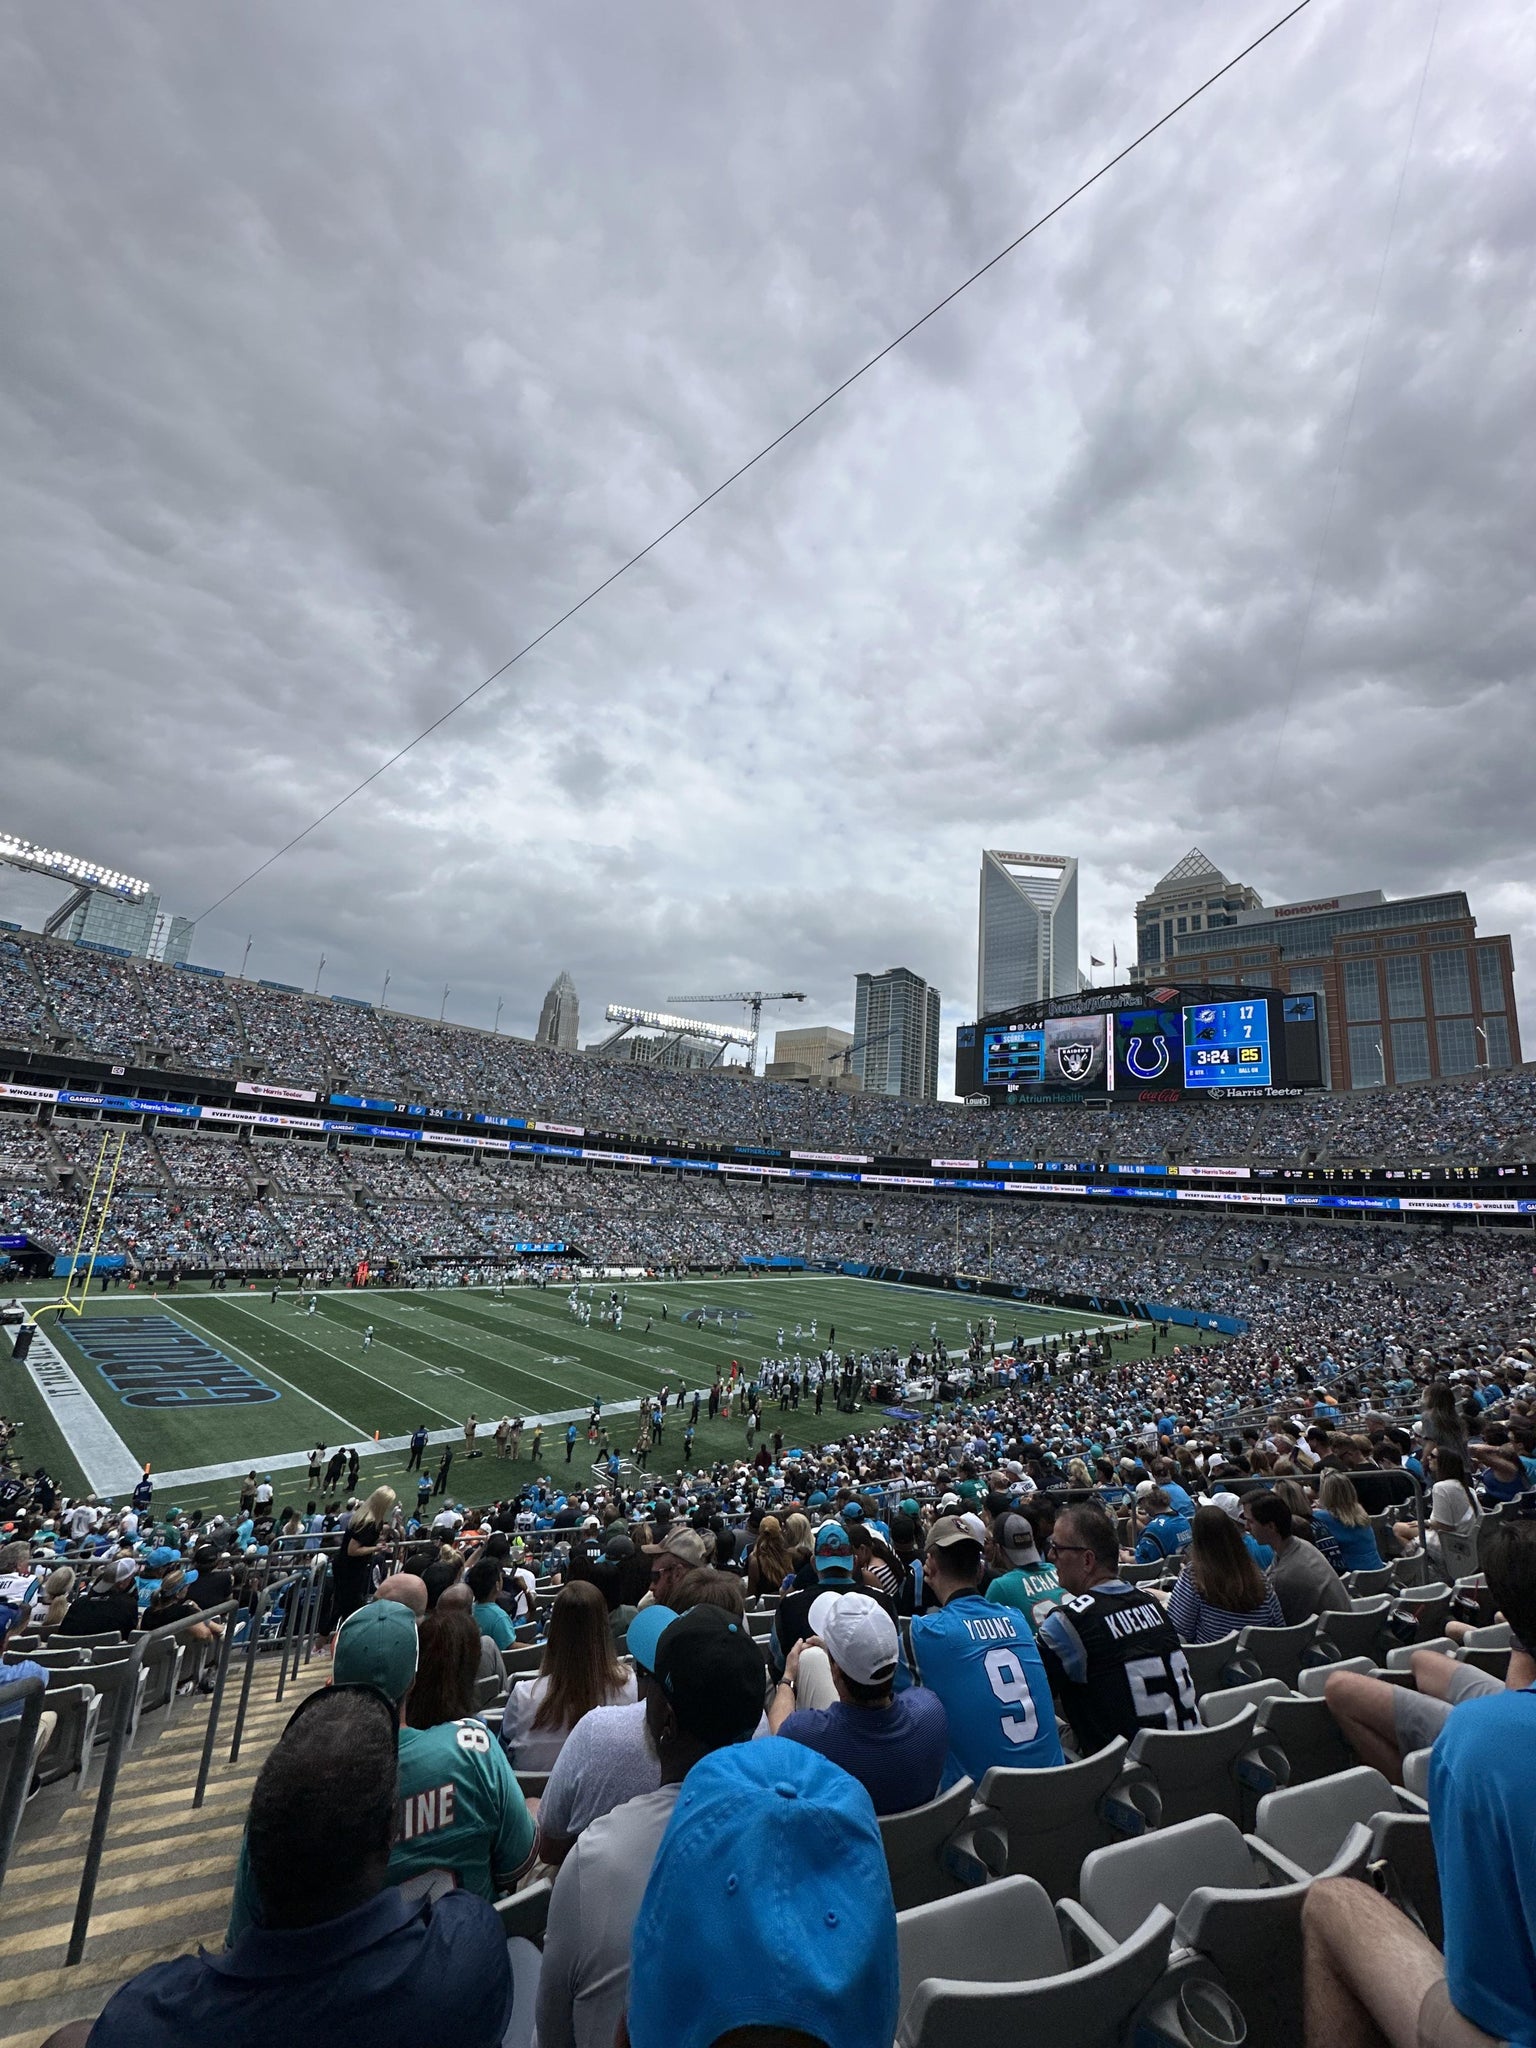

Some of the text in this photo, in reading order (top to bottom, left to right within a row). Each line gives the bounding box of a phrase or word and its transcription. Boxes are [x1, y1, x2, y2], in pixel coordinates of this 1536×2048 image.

[998, 852, 1066, 864] WELLS FARGO
[1275, 899, 1339, 918] Honeywell
[1048, 1001, 1077, 1016] Bank
[1090, 996, 1142, 1011] America
[1239, 1006, 1254, 1020] 17
[1243, 1025, 1252, 1039] 7
[1197, 1048, 1259, 1065] 3:24 25
[9, 1088, 38, 1097] WHOLE
[263, 1087, 302, 1098] Harris Teeter
[1018, 1091, 1084, 1104] Atrium Health
[1226, 1087, 1303, 1098] Harris Teeter
[68, 1096, 104, 1104] GAMEDAY
[140, 1103, 161, 1111] Harris
[161, 1105, 184, 1113] Teeter
[428, 1108, 444, 1118] 3:24
[484, 1116, 499, 1125] BALL
[735, 1147, 782, 1156] PANTHERS.COM
[1168, 1166, 1178, 1175] 25
[57, 1314, 282, 1409] CAROLINA
[32, 1361, 74, 1386] TAKES
[47, 1388, 81, 1398] IT
[963, 1615, 1017, 1641] YOUNG
[1104, 1602, 1165, 1640] KUECHLY
[983, 1647, 1040, 1745] 9
[1124, 1649, 1205, 1731] 59
[397, 1783, 454, 1841] INE
